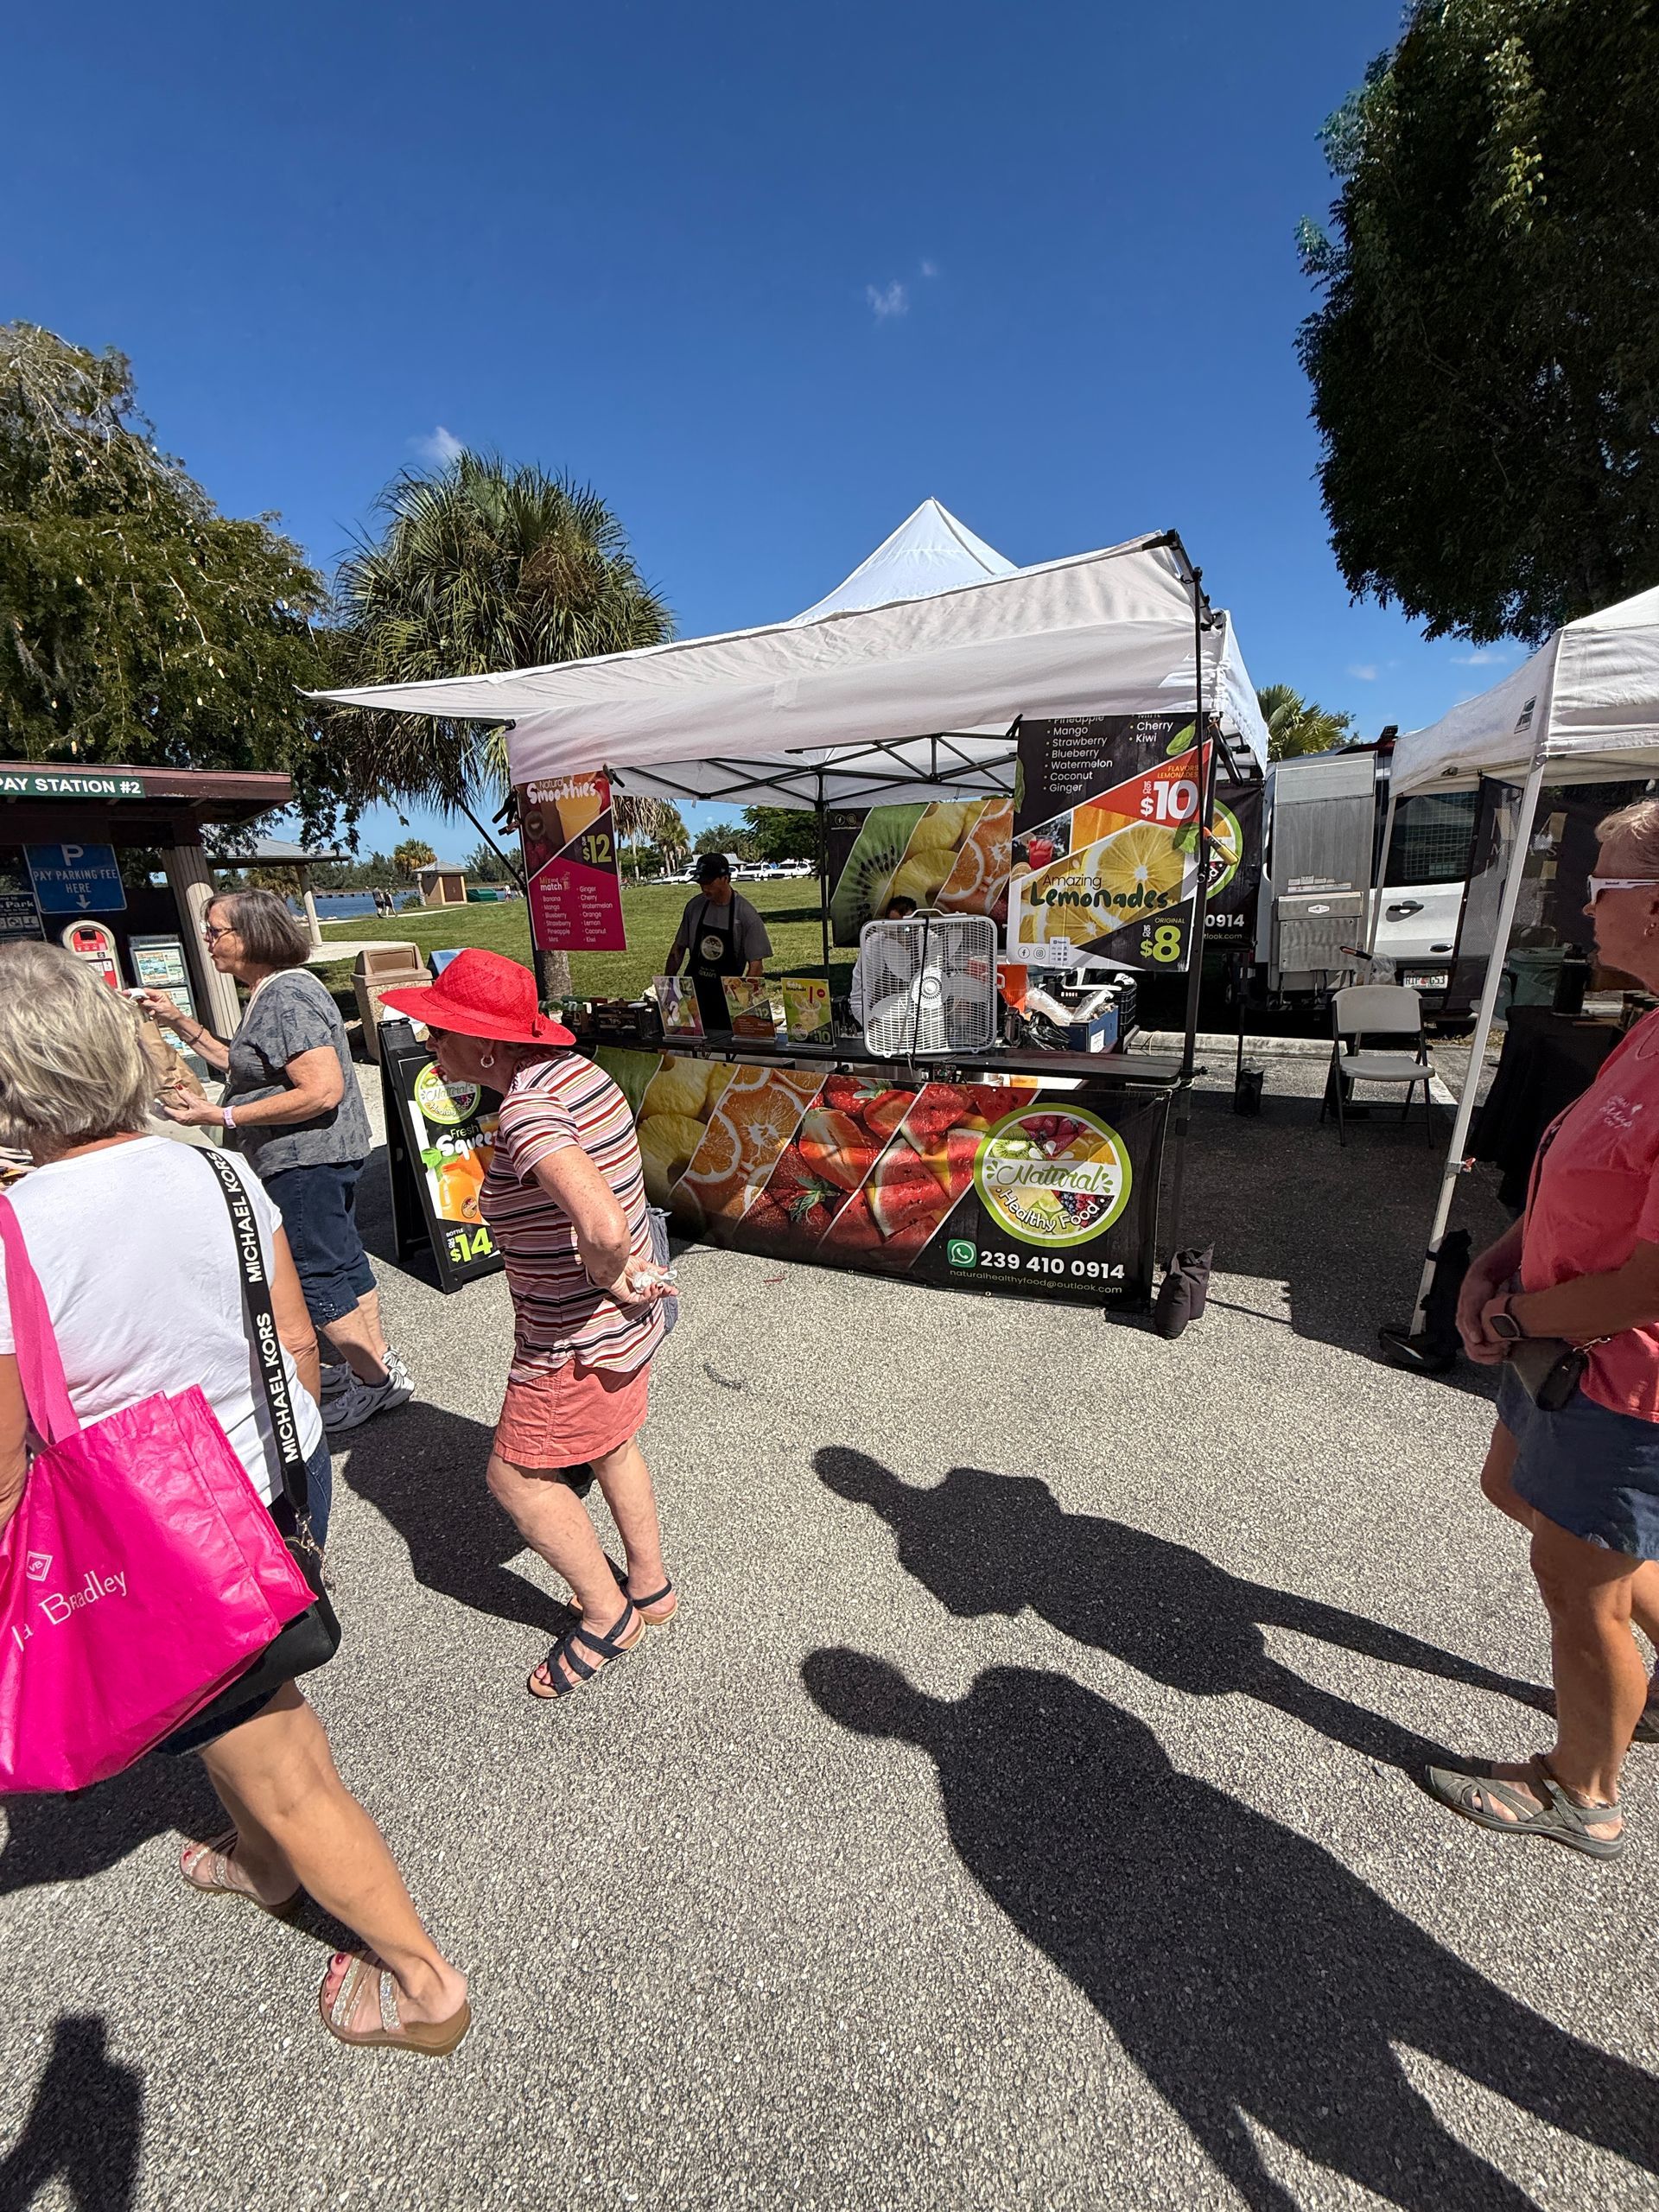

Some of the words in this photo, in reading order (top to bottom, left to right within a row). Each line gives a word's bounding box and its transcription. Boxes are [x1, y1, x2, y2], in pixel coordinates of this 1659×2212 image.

[1053, 727, 1089, 736] Mango
[1136, 721, 1173, 733] Cherry
[1052, 737, 1108, 747] Strawberry
[1135, 733, 1157, 743] Kiwi
[1052, 748, 1099, 759] Blueberry
[1051, 759, 1113, 769] Watermelon
[1050, 771, 1093, 781] Coconut
[35, 778, 116, 793] STATION
[119, 781, 142, 794] #2
[527, 779, 596, 804] Smoothies
[1049, 783, 1083, 794] Ginger
[1141, 779, 1198, 821] $10
[60, 844, 84, 867] P
[582, 833, 612, 864] $12
[34, 871, 52, 881] PAY
[55, 869, 98, 880] PARKING
[100, 869, 118, 879] FEE
[1042, 874, 1103, 890] Amazing
[66, 883, 92, 893] HERE
[541, 881, 563, 892] match
[1030, 881, 1168, 909] Lemonades
[5, 900, 35, 909] Park
[1205, 914, 1244, 927] 0914
[1140, 925, 1181, 963] $8
[450, 1123, 480, 1139] Fresh
[207, 1151, 242, 1193] KORS
[996, 1165, 1104, 1192] Natural
[999, 1189, 1057, 1232] Healthy
[1058, 1199, 1101, 1229] Food
[232, 1194, 264, 1283] MICHAEL
[446, 1228, 464, 1237] BOTTLE
[449, 1227, 493, 1262] $14
[980, 1251, 1020, 1270] 239
[1026, 1256, 1065, 1275] 410
[1071, 1260, 1125, 1280] 0914
[950, 1269, 1122, 1294] naturalhealthyfood@outlook.com
[256, 1313, 280, 1368] KORS
[270, 1369, 300, 1465] MICHAEL
